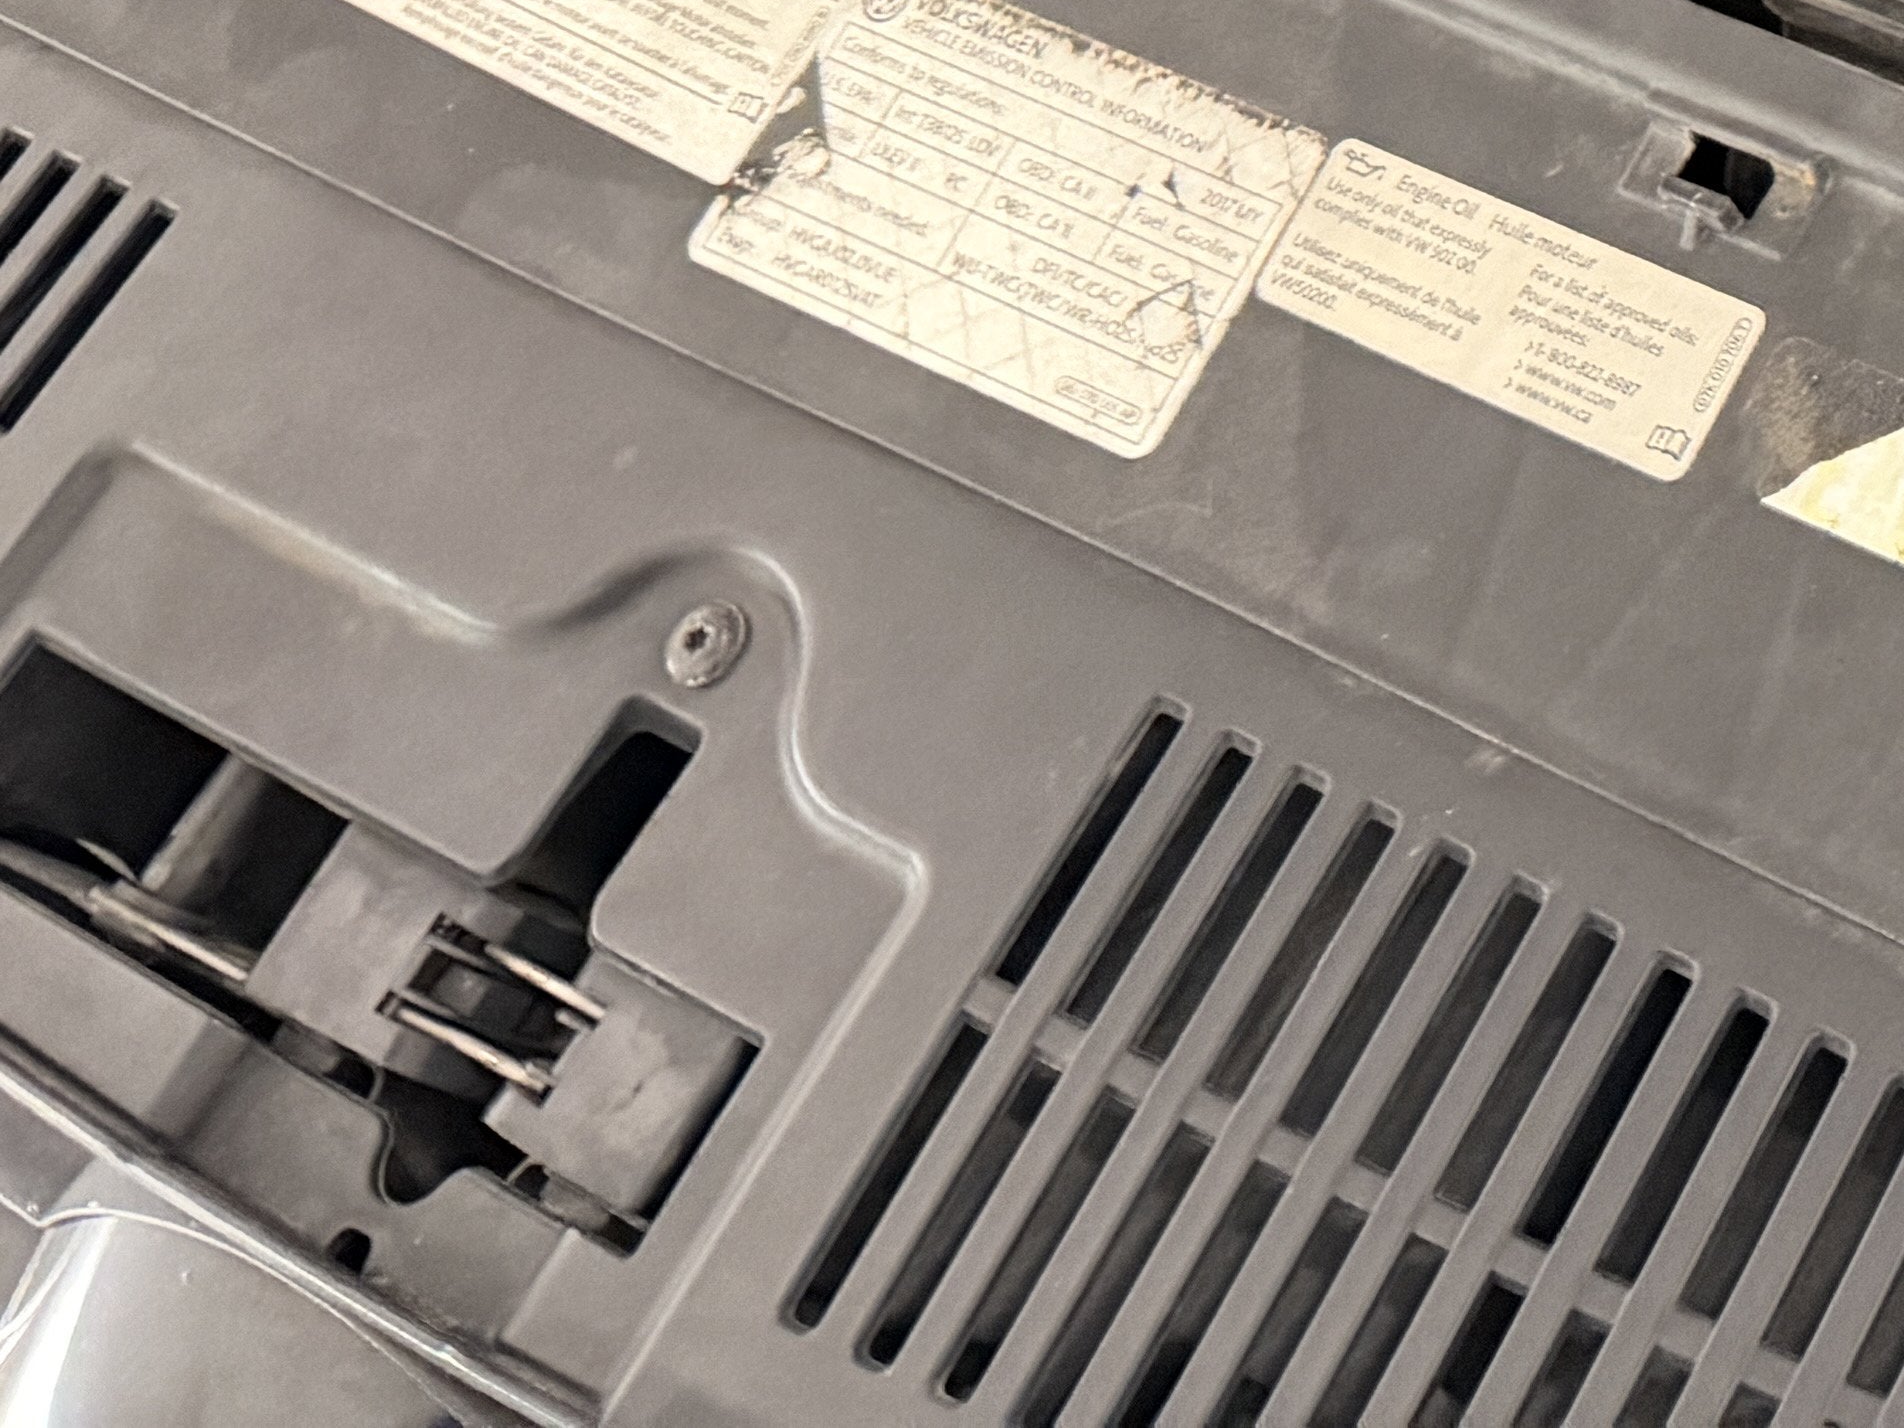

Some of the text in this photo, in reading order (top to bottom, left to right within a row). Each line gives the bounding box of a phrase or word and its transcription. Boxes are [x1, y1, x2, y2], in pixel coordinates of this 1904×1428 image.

[1312, 197, 1373, 230] complies
[1371, 224, 1404, 243] with
[1324, 175, 1492, 260] Use only oil that expressly
[1394, 173, 1598, 270] Engine Oil Huile moteur
[1280, 253, 1306, 271] qui
[1516, 283, 1553, 307] Pour
[1550, 304, 1580, 321] une
[1578, 308, 1610, 334] liste
[1528, 262, 1555, 283] For
[1551, 275, 1564, 289] a
[1563, 276, 1589, 299] list
[1602, 297, 1671, 333] approved
